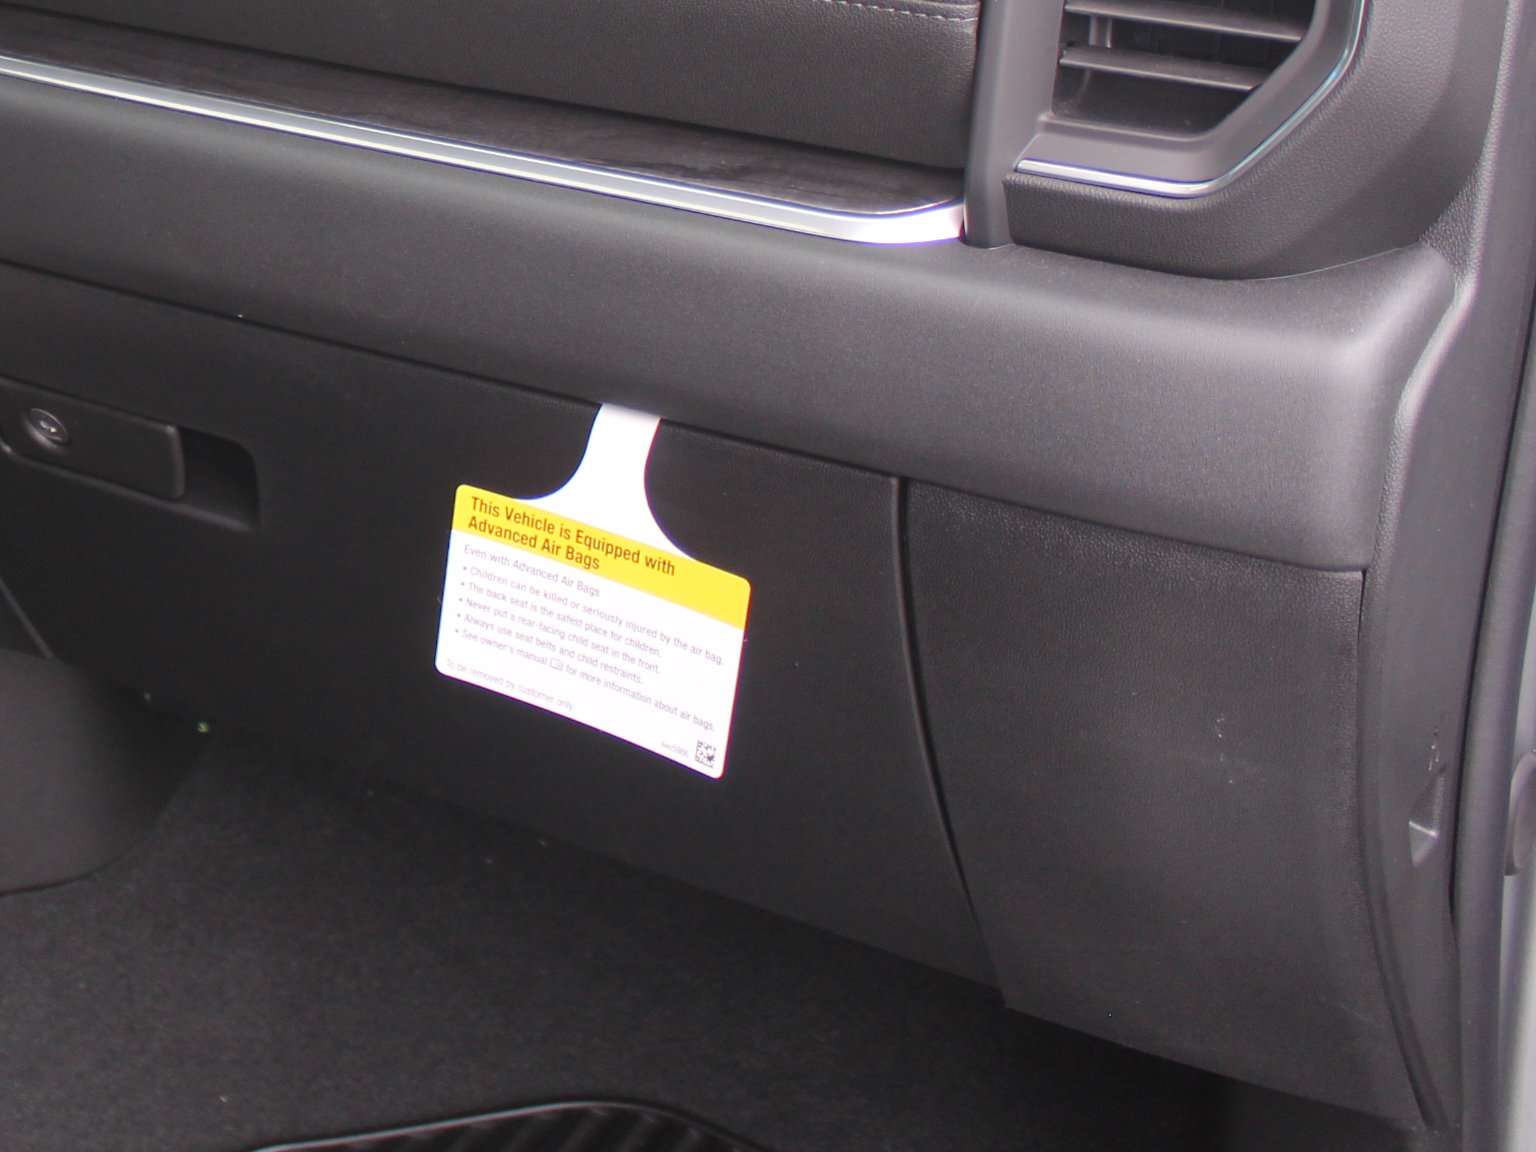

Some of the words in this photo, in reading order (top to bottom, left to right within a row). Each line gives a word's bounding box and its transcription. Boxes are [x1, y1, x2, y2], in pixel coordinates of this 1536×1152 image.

[468, 516, 537, 548] Advanced
[542, 538, 561, 556] Air
[566, 545, 600, 570] Bags
[471, 496, 500, 517] This
[505, 506, 555, 534] Vehicle
[559, 523, 571, 540] is
[576, 529, 640, 564] Equipped
[645, 556, 675, 576] with
[464, 545, 486, 559] Even
[490, 554, 510, 567] with
[513, 560, 558, 582] Advanced
[561, 576, 574, 588] Air
[577, 581, 600, 597] Bags
[464, 614, 494, 630] Always
[498, 626, 512, 636] use
[515, 632, 533, 644] seat
[536, 638, 556, 652] belts
[559, 647, 575, 658] and
[577, 654, 598, 667] child
[467, 598, 491, 612] Never
[494, 608, 507, 618] put
[568, 633, 588, 647] child
[591, 642, 609, 654] seat
[612, 649, 619, 658] in
[622, 652, 636, 664] the
[469, 582, 483, 594] The
[487, 588, 506, 601] back
[510, 596, 528, 609] seat
[531, 602, 537, 612] is
[540, 606, 554, 618] the
[557, 614, 582, 628] safest
[585, 623, 607, 636] place
[611, 631, 622, 641] for
[470, 566, 507, 585] Children
[510, 581, 526, 592] can
[530, 585, 540, 596] be
[544, 590, 568, 605] killed
[571, 601, 580, 609] or
[582, 605, 623, 627] seriously
[626, 619, 657, 638] injured
[660, 632, 670, 644] by
[674, 638, 688, 650] the
[690, 645, 703, 656] air
[462, 630, 478, 641] See
[516, 648, 547, 665] manual
[566, 664, 577, 675] for
[580, 671, 601, 685] more
[604, 679, 651, 704] information
[654, 699, 678, 716] about
[680, 709, 691, 721] air
